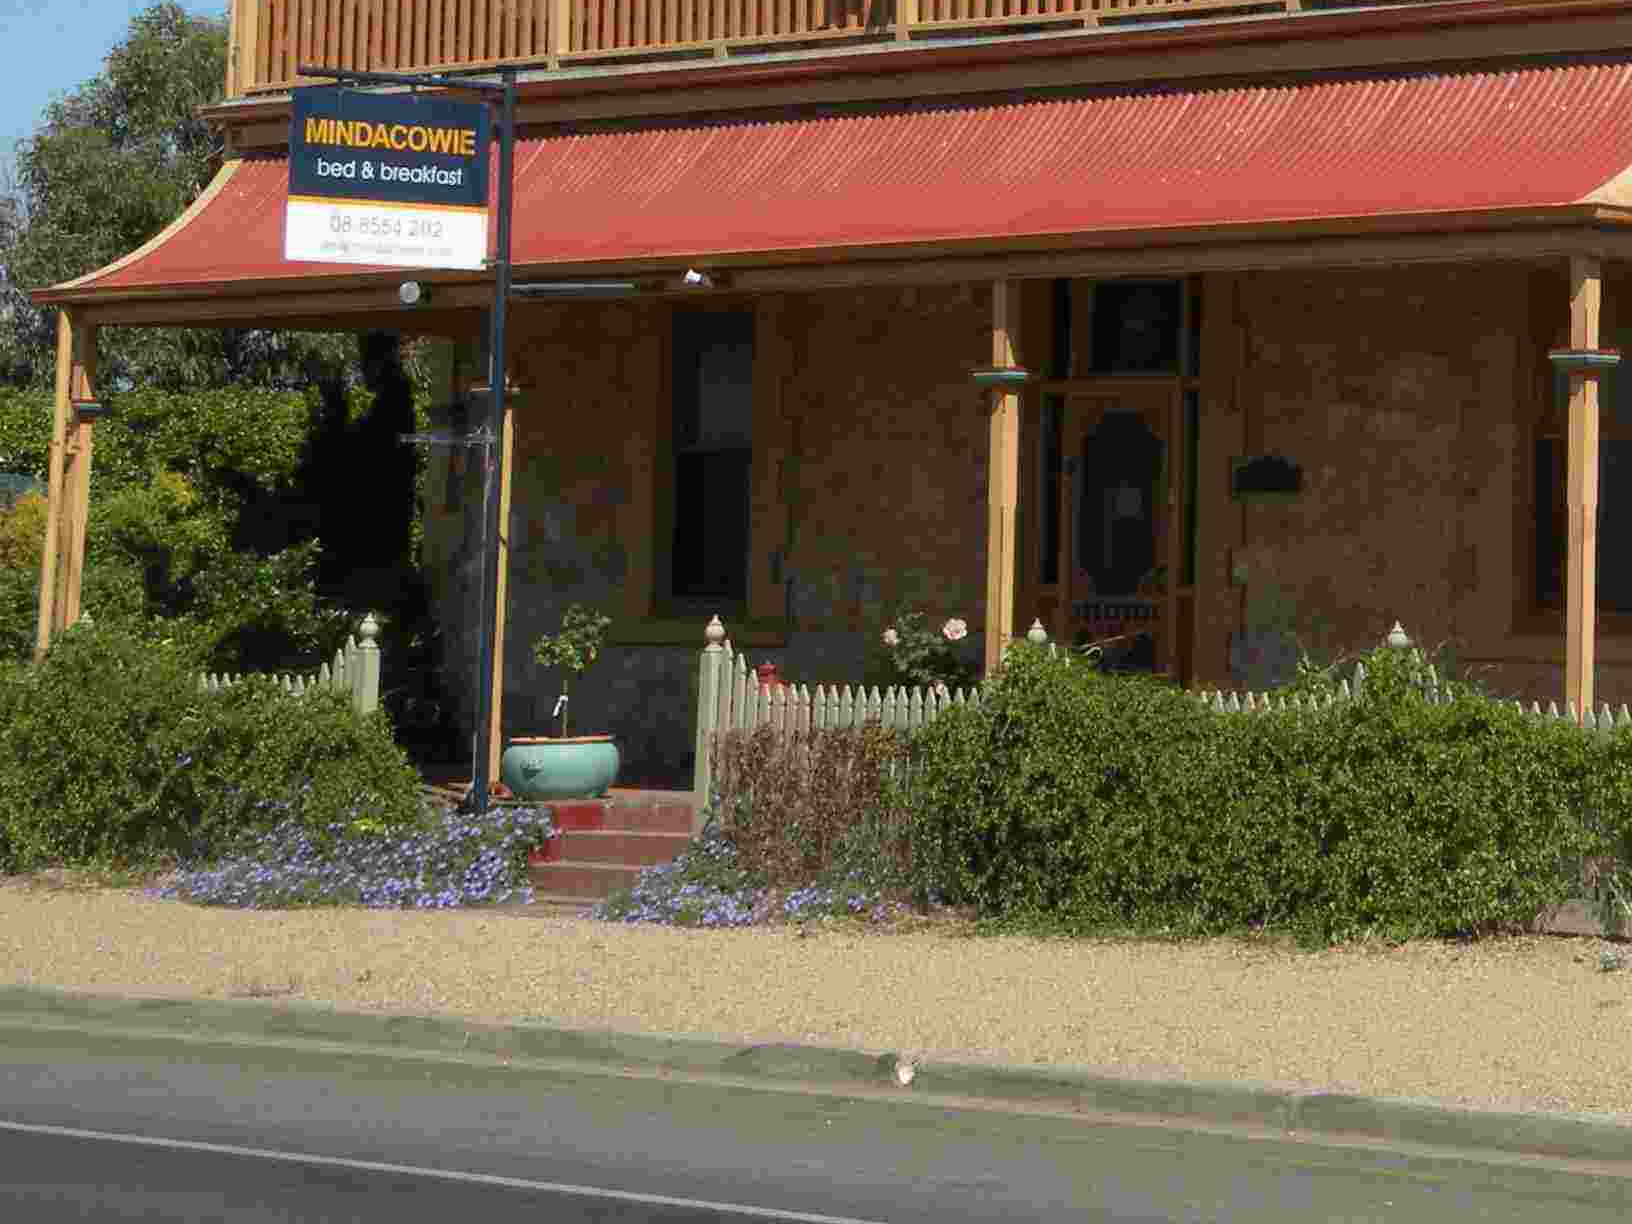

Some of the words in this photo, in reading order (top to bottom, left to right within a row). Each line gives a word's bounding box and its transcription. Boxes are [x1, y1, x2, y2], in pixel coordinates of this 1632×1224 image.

[305, 118, 477, 156] MINDACOWIE
[316, 157, 356, 180] bed
[361, 160, 376, 180] &
[380, 161, 464, 186] breakfast
